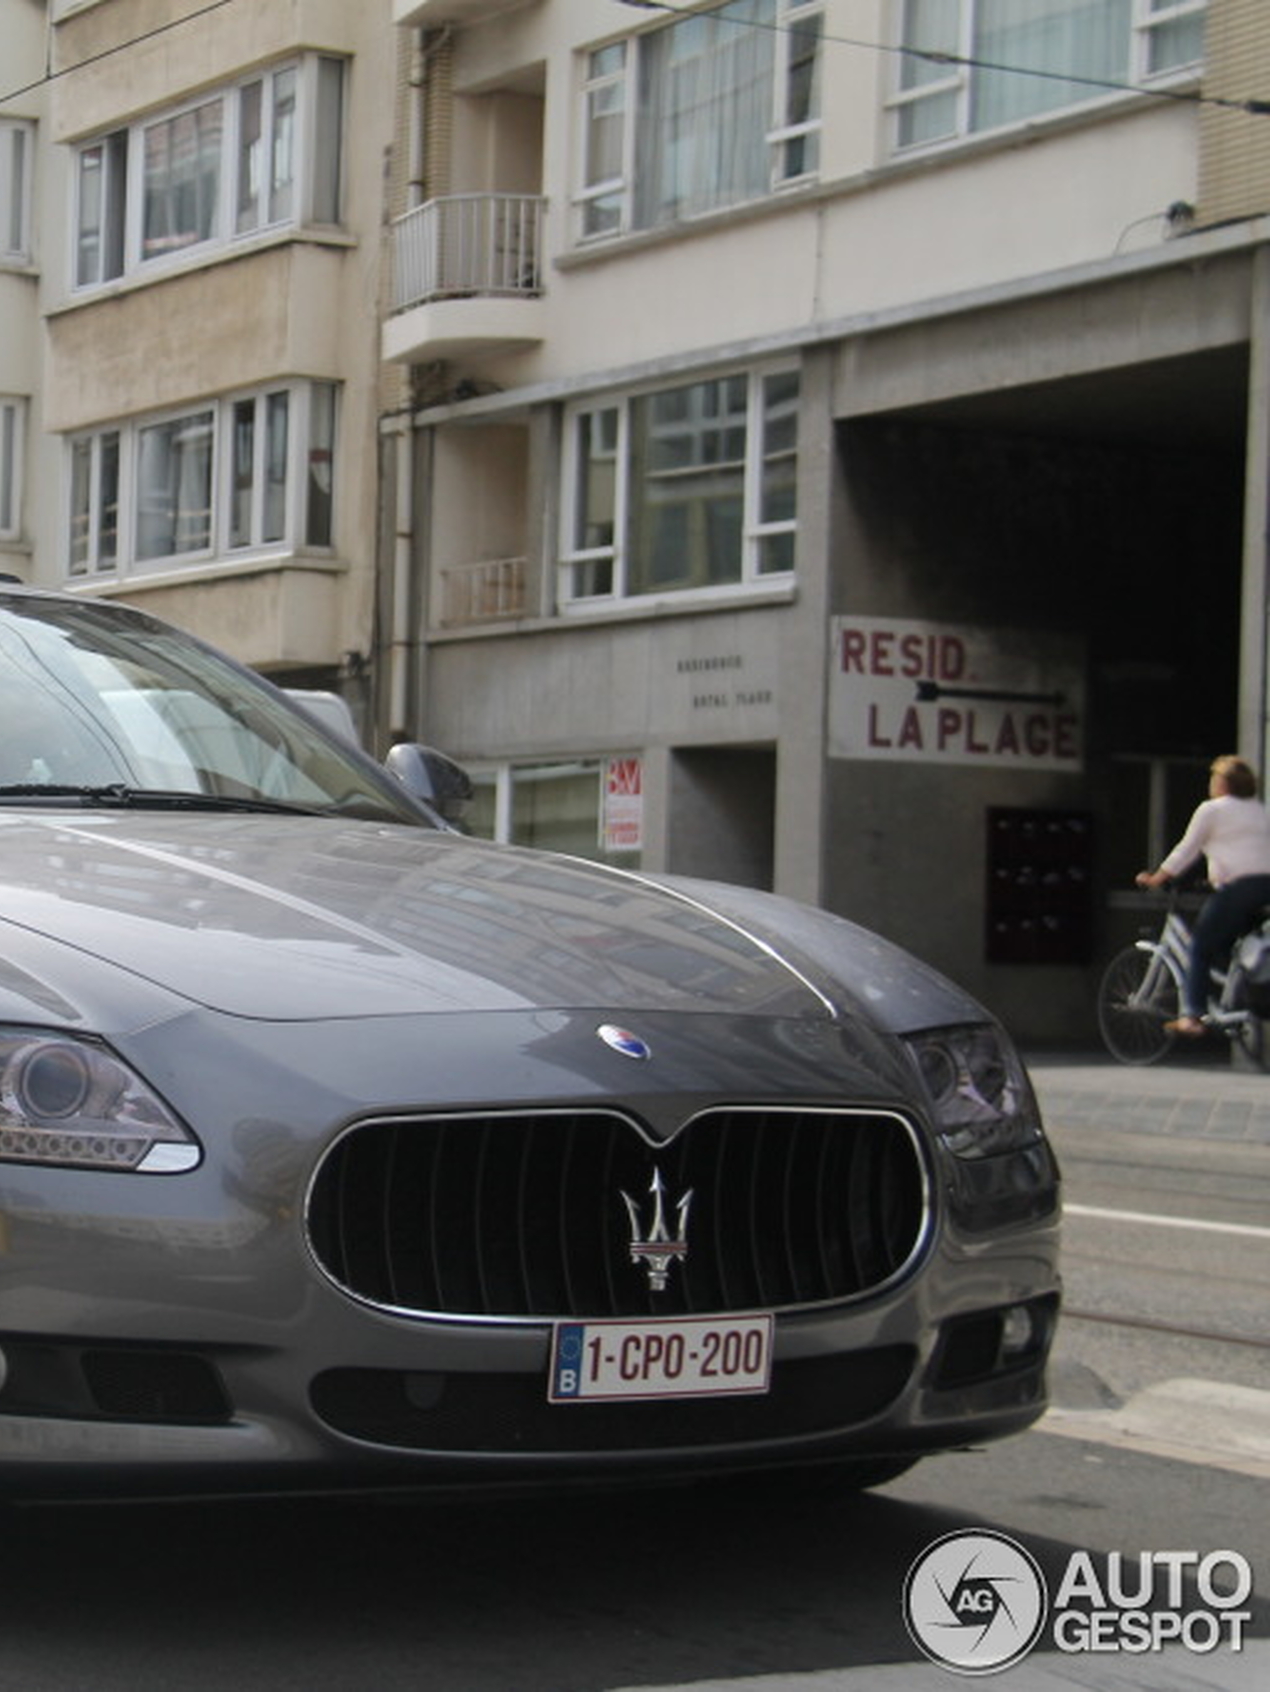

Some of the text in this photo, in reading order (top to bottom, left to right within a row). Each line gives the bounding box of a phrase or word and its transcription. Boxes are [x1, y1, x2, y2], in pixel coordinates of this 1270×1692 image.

[867, 703, 1078, 759] LA PLAGE
[558, 1368, 577, 1393] B
[587, 1329, 764, 1382] 1-CPO-200
